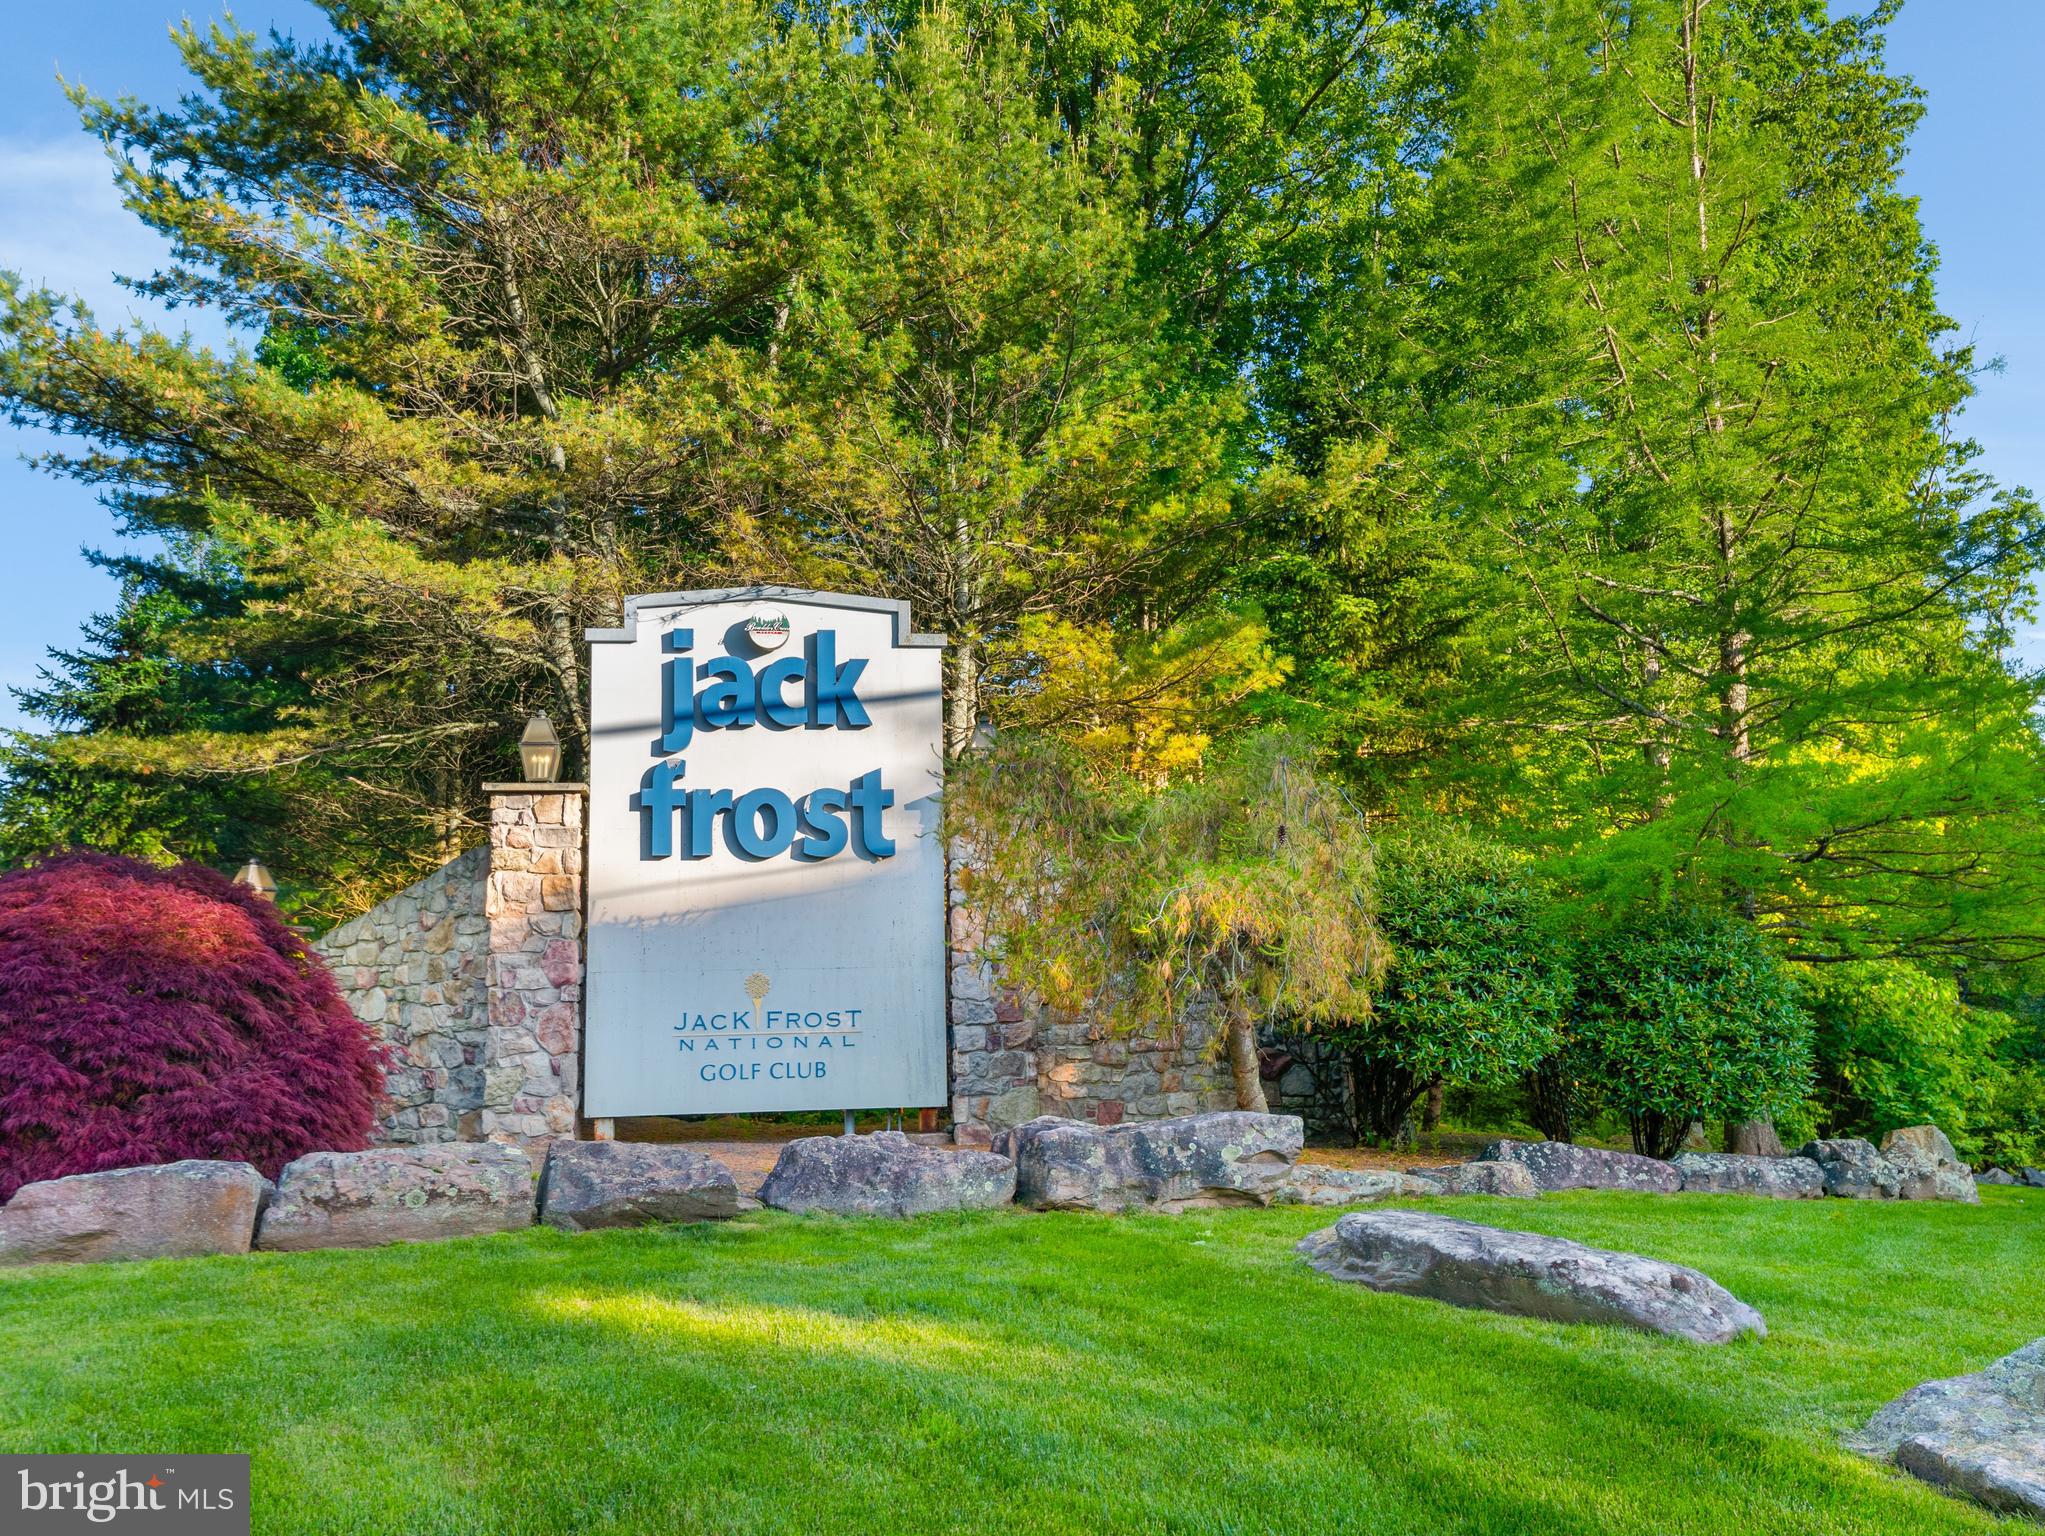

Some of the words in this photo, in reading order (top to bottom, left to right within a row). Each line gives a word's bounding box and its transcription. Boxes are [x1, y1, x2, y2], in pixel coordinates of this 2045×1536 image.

[662, 628, 873, 752] jack
[641, 759, 895, 858] frost
[674, 1011, 750, 1031] JACK
[767, 1010, 862, 1029] FROST
[679, 1036, 855, 1051] NATIONAL
[700, 1063, 761, 1082] GOLF
[769, 1061, 827, 1080] CLUB
